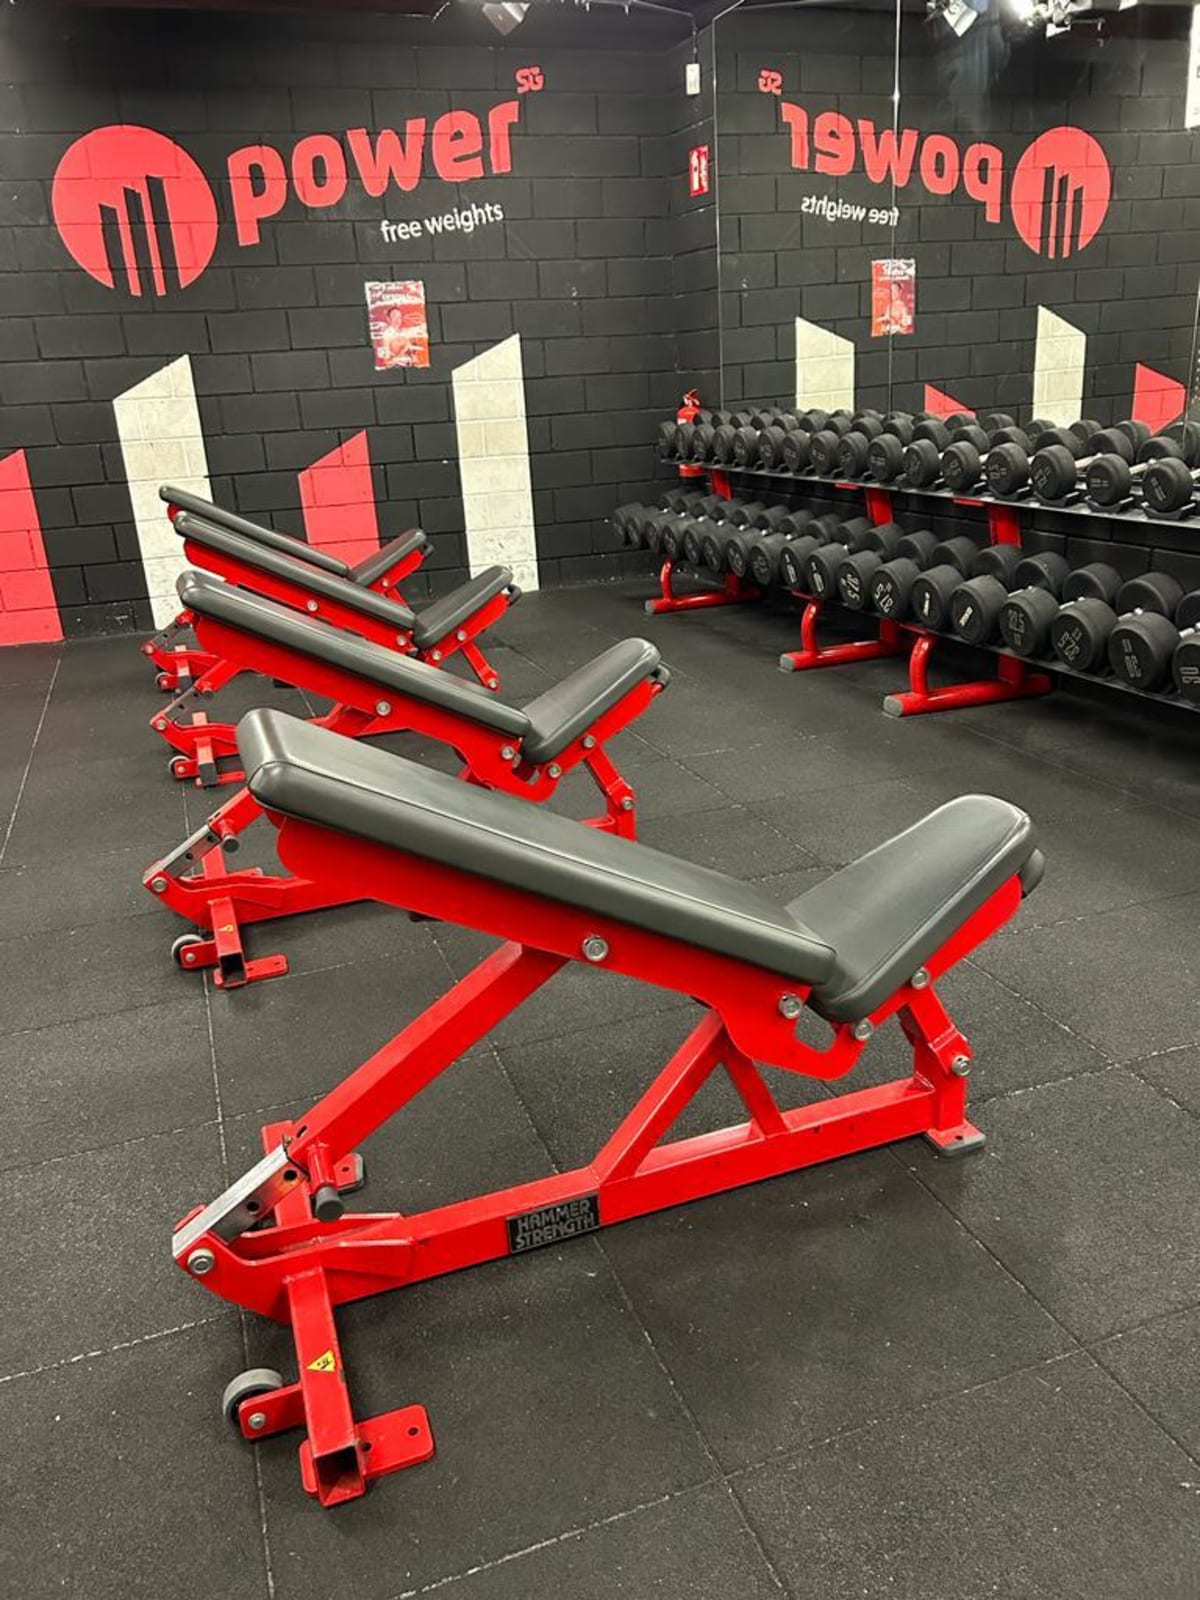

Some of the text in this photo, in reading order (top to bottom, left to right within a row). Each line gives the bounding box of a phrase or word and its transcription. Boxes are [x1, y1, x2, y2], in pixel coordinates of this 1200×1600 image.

[227, 101, 520, 246] power
[380, 202, 504, 243] free weights
[515, 1212, 595, 1250] STRENGTH
[518, 1198, 591, 1236] HAMMER
